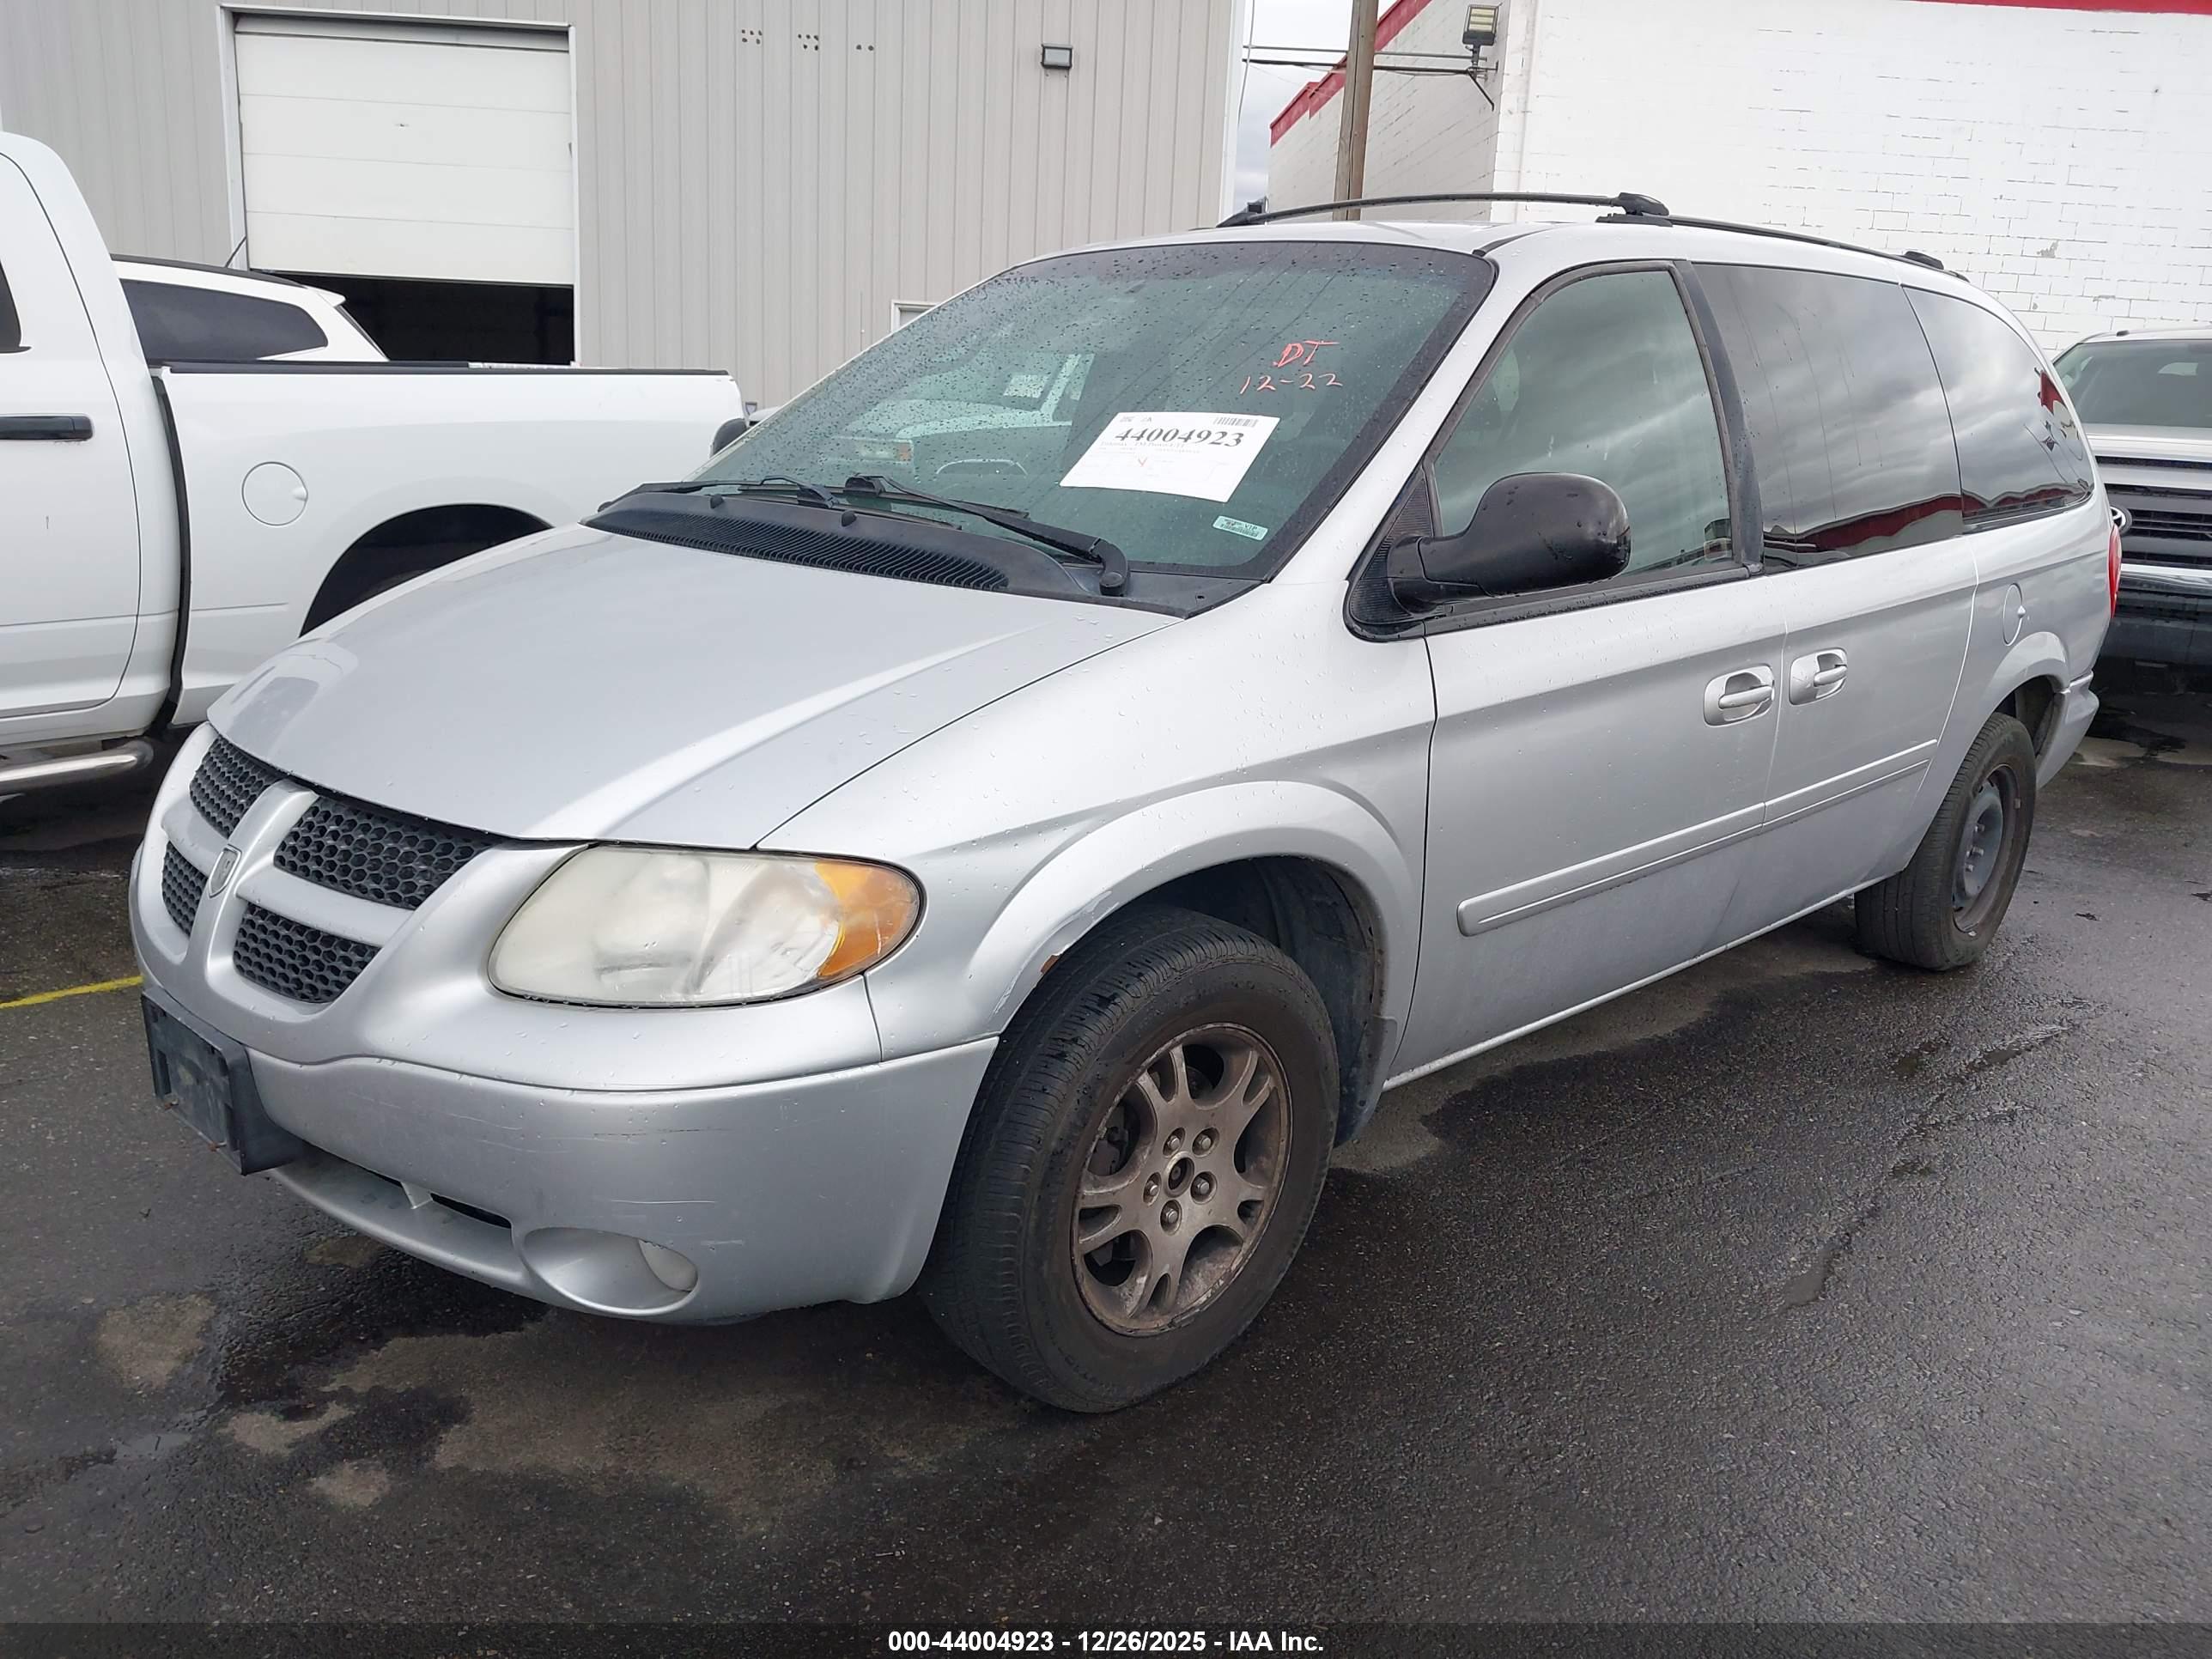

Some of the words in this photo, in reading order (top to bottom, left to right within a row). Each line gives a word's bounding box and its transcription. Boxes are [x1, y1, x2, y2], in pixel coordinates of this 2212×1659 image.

[1273, 339, 1340, 368] DT
[1239, 373, 1343, 395] 12-22
[1115, 428, 1244, 447] 44004923
